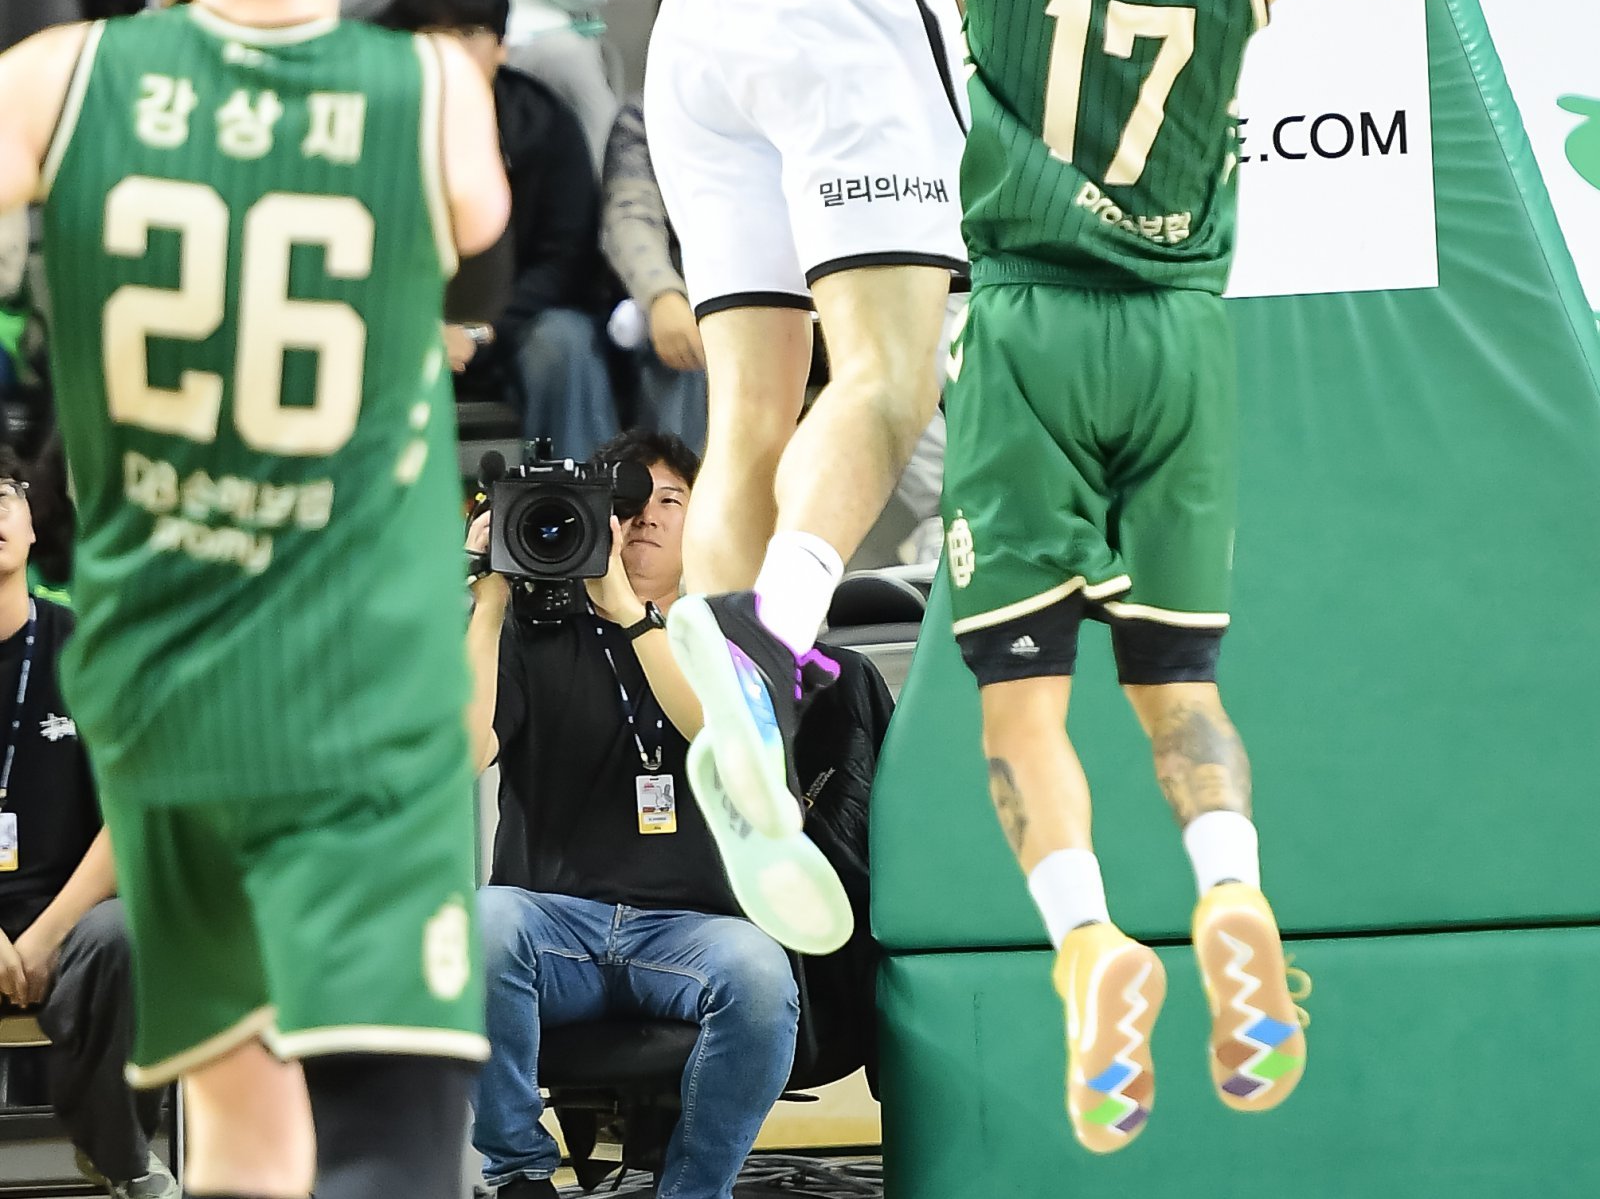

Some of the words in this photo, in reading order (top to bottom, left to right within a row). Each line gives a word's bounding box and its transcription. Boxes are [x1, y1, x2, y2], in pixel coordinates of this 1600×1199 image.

[134, 73, 368, 167] 강상재
[819, 173, 950, 208] 밀리의서재
[101, 173, 376, 457] 26
